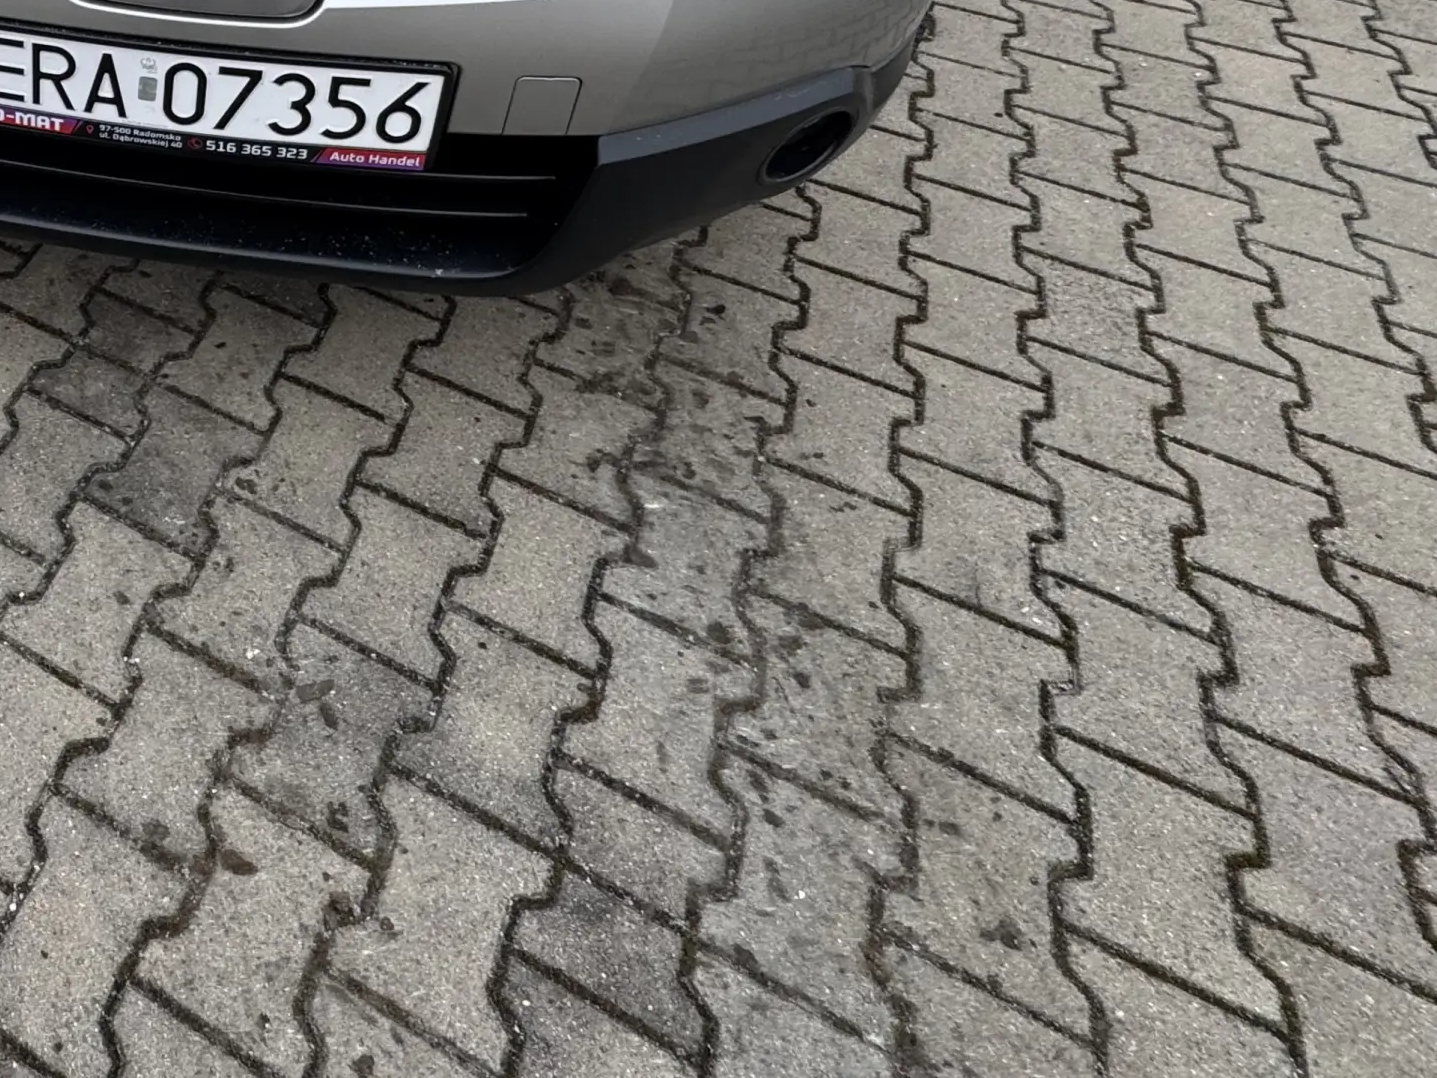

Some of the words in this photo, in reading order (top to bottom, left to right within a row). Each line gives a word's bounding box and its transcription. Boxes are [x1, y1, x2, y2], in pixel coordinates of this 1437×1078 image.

[162, 62, 432, 144] 07356
[99, 124, 131, 135] 97-500
[133, 129, 181, 141] Radomsko
[112, 133, 169, 149] Dąbrowskiej
[205, 140, 237, 154] 516
[241, 144, 272, 157] 365
[277, 147, 308, 160] 323
[329, 151, 364, 164] Auto
[368, 154, 421, 167] Handel
